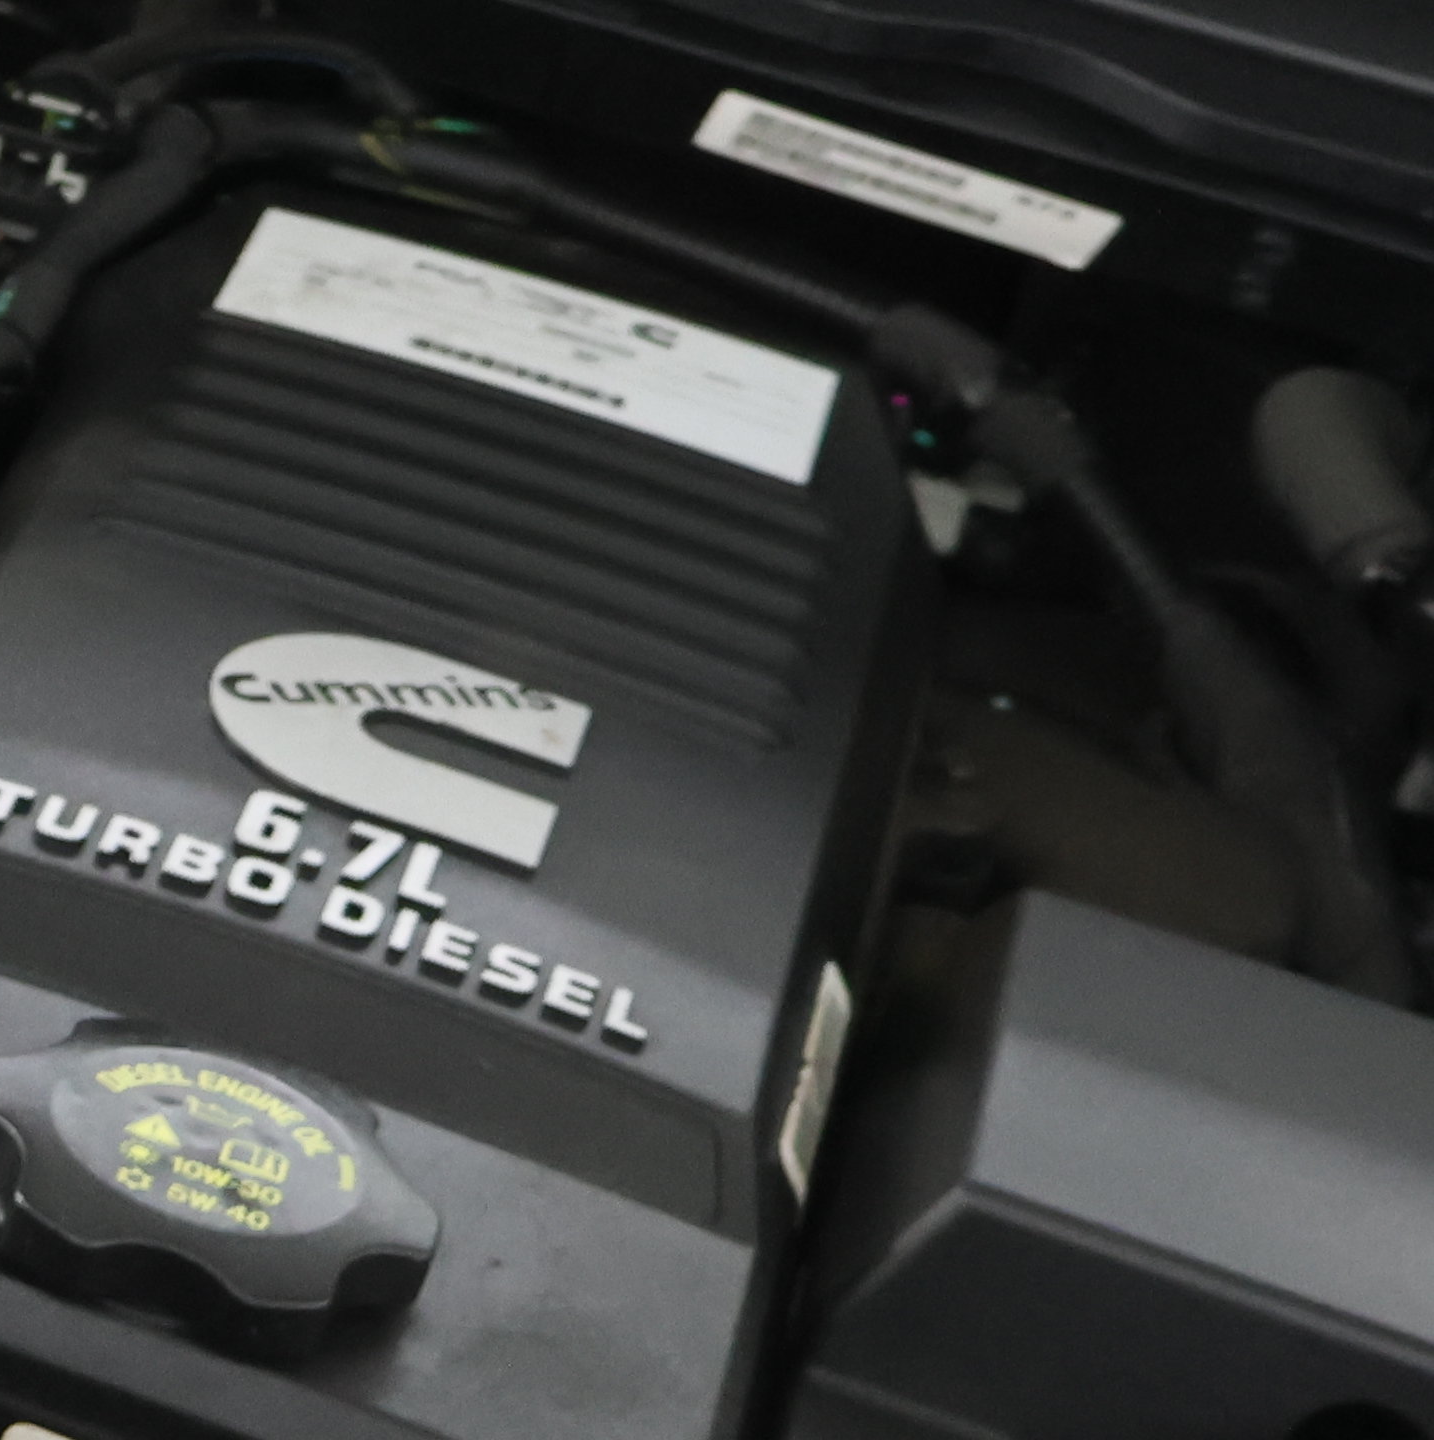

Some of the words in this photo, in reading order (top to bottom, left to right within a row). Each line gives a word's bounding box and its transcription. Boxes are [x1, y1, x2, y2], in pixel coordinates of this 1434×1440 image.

[219, 672, 559, 712] Cummins
[234, 789, 447, 911] 6.7L
[318, 884, 648, 1044] DIESEL
